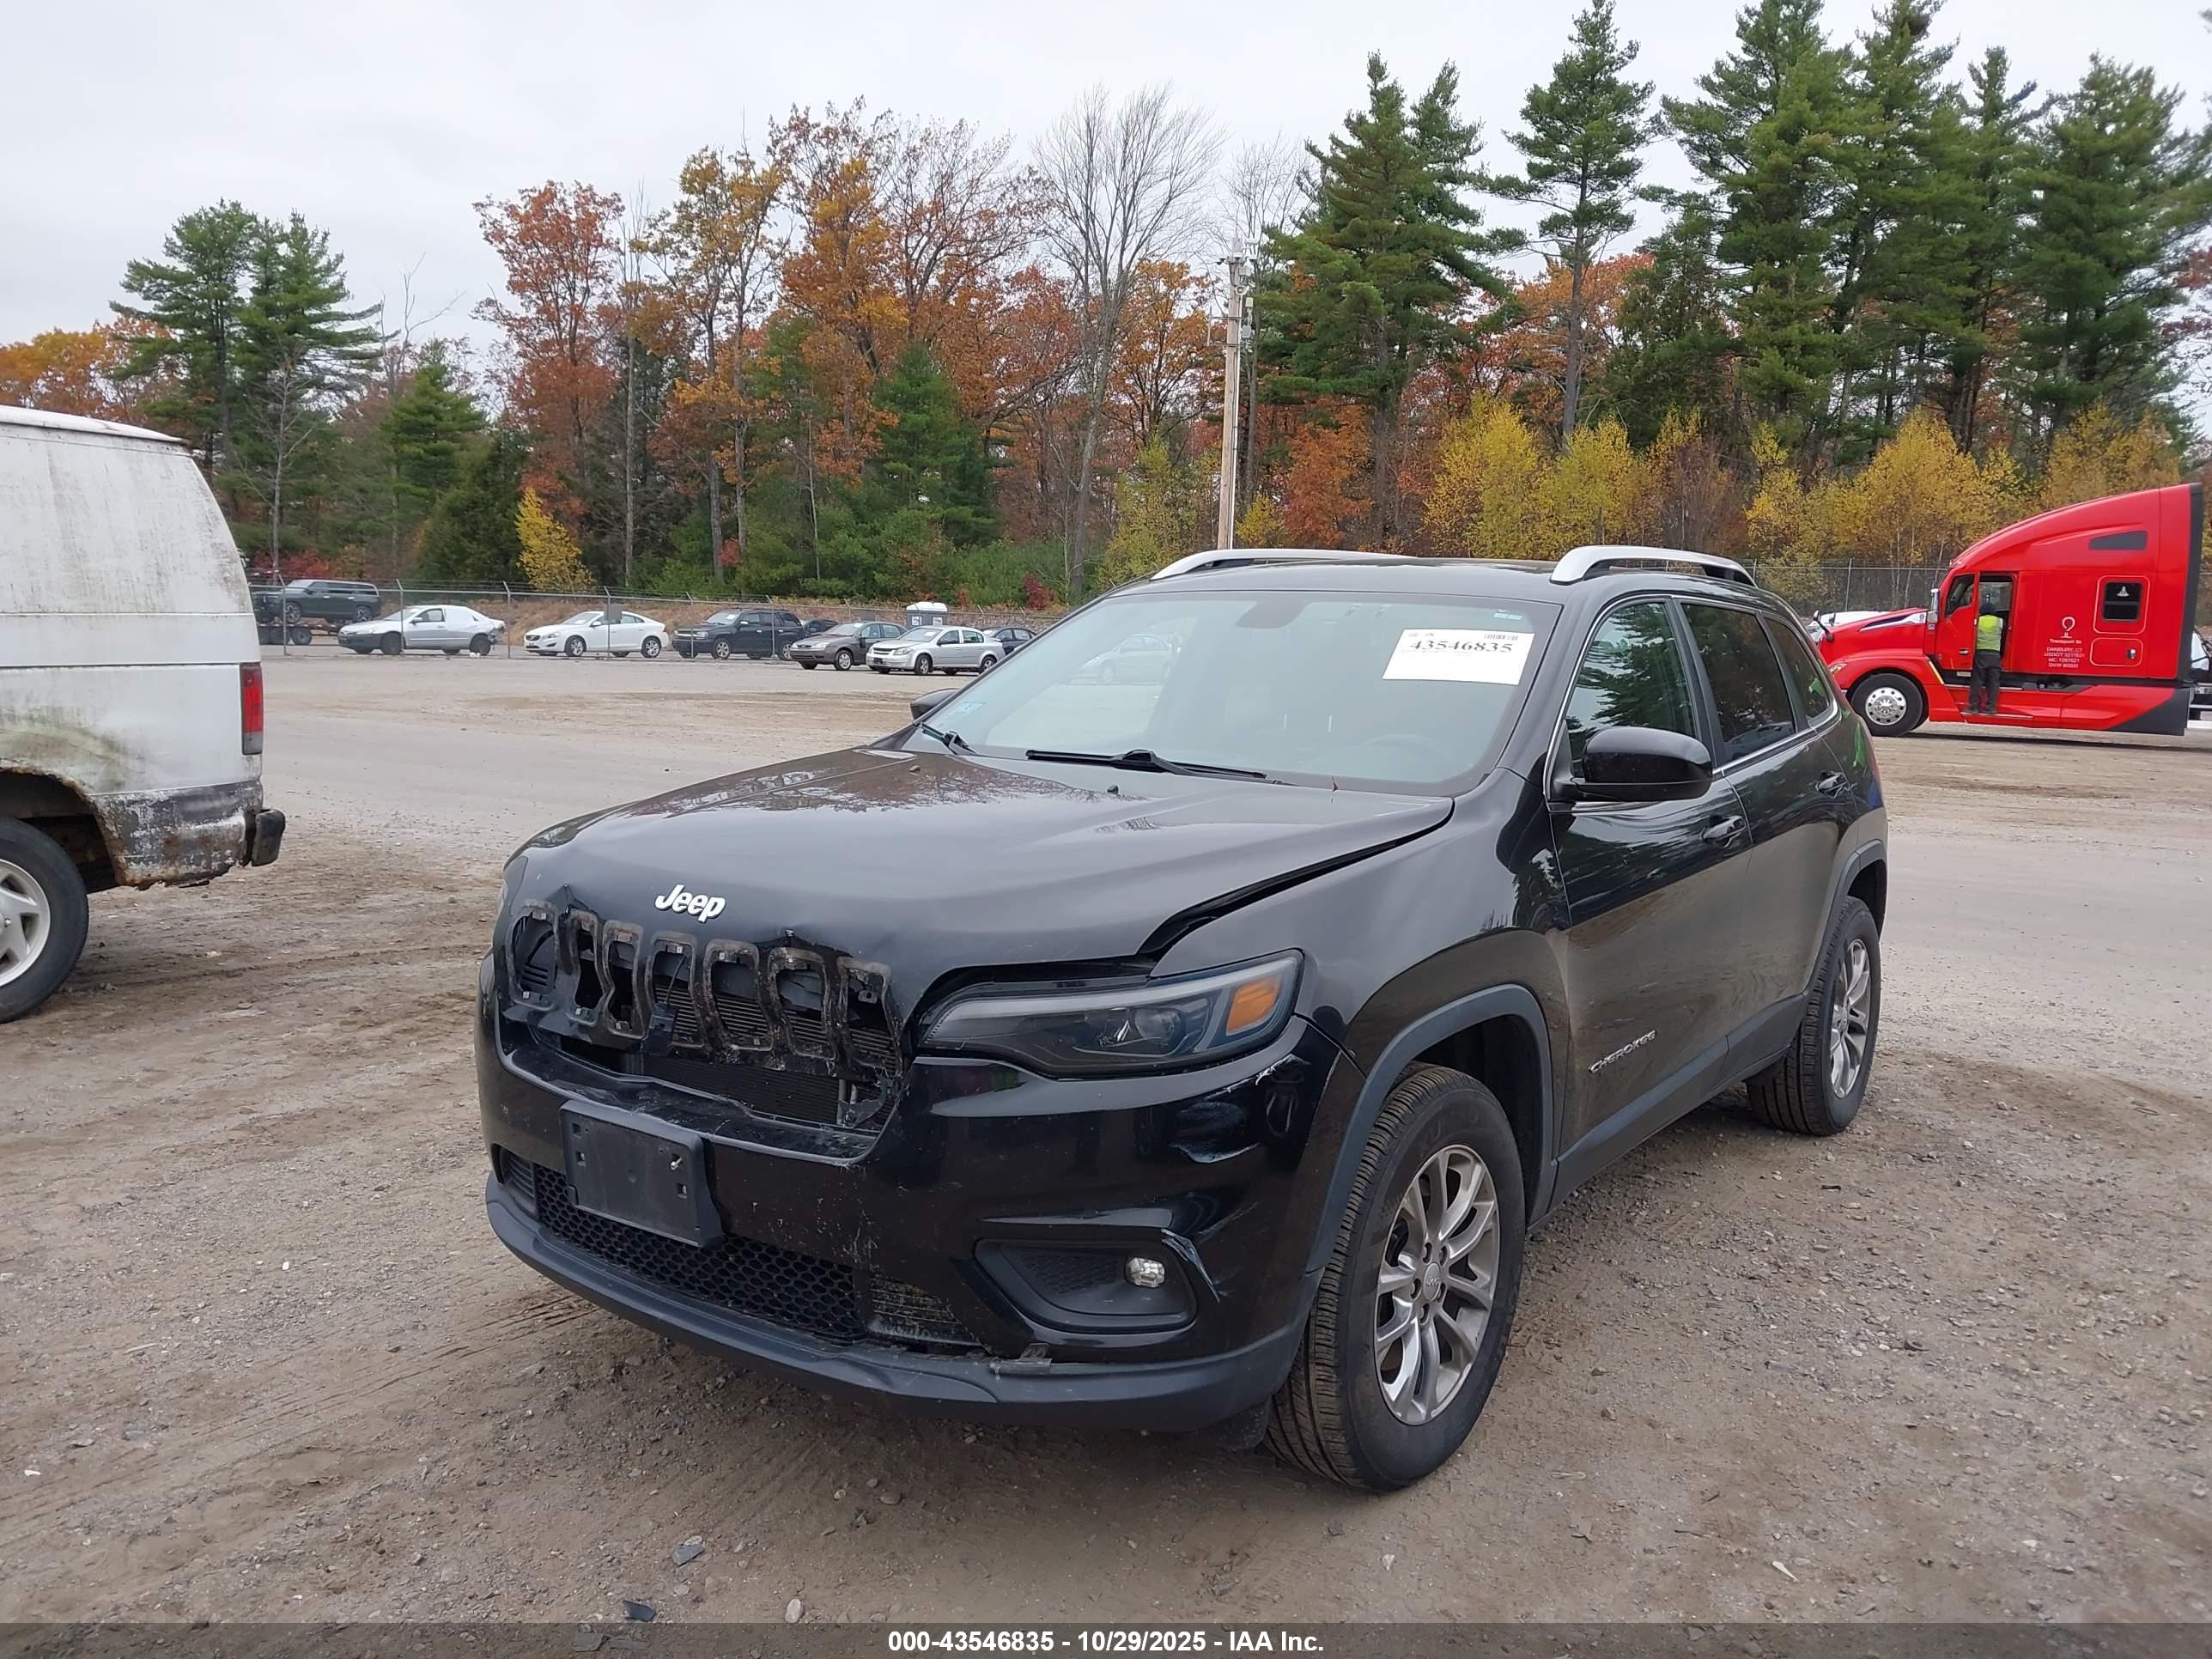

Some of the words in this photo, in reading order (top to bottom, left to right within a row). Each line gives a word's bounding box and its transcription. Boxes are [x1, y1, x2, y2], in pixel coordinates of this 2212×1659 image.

[1409, 640, 1513, 653] 43546835
[654, 884, 726, 923] Jeep
[1588, 1030, 1656, 1073] CHEROKEE
